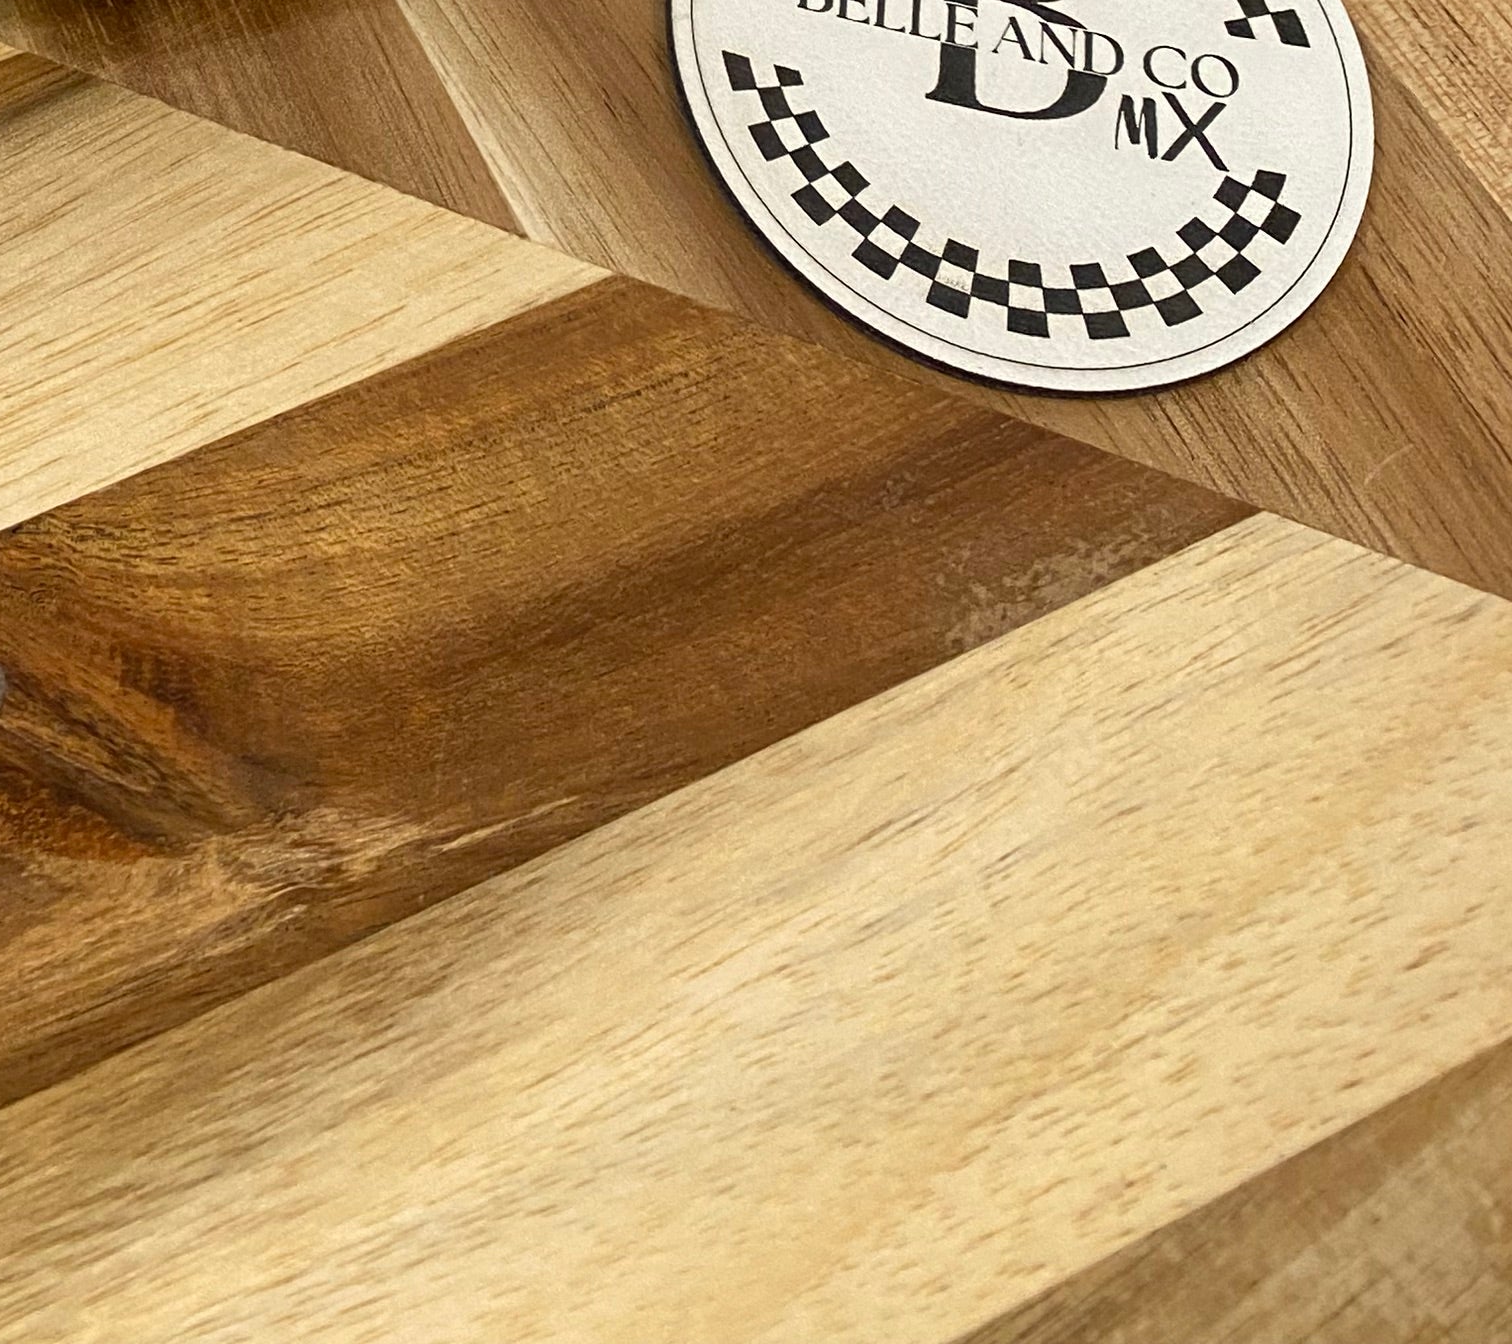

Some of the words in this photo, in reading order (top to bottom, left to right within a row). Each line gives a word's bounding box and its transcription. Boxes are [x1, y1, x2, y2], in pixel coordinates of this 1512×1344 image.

[992, 16, 1126, 77] AND
[1143, 44, 1241, 99] CO
[1114, 91, 1230, 173] MX
